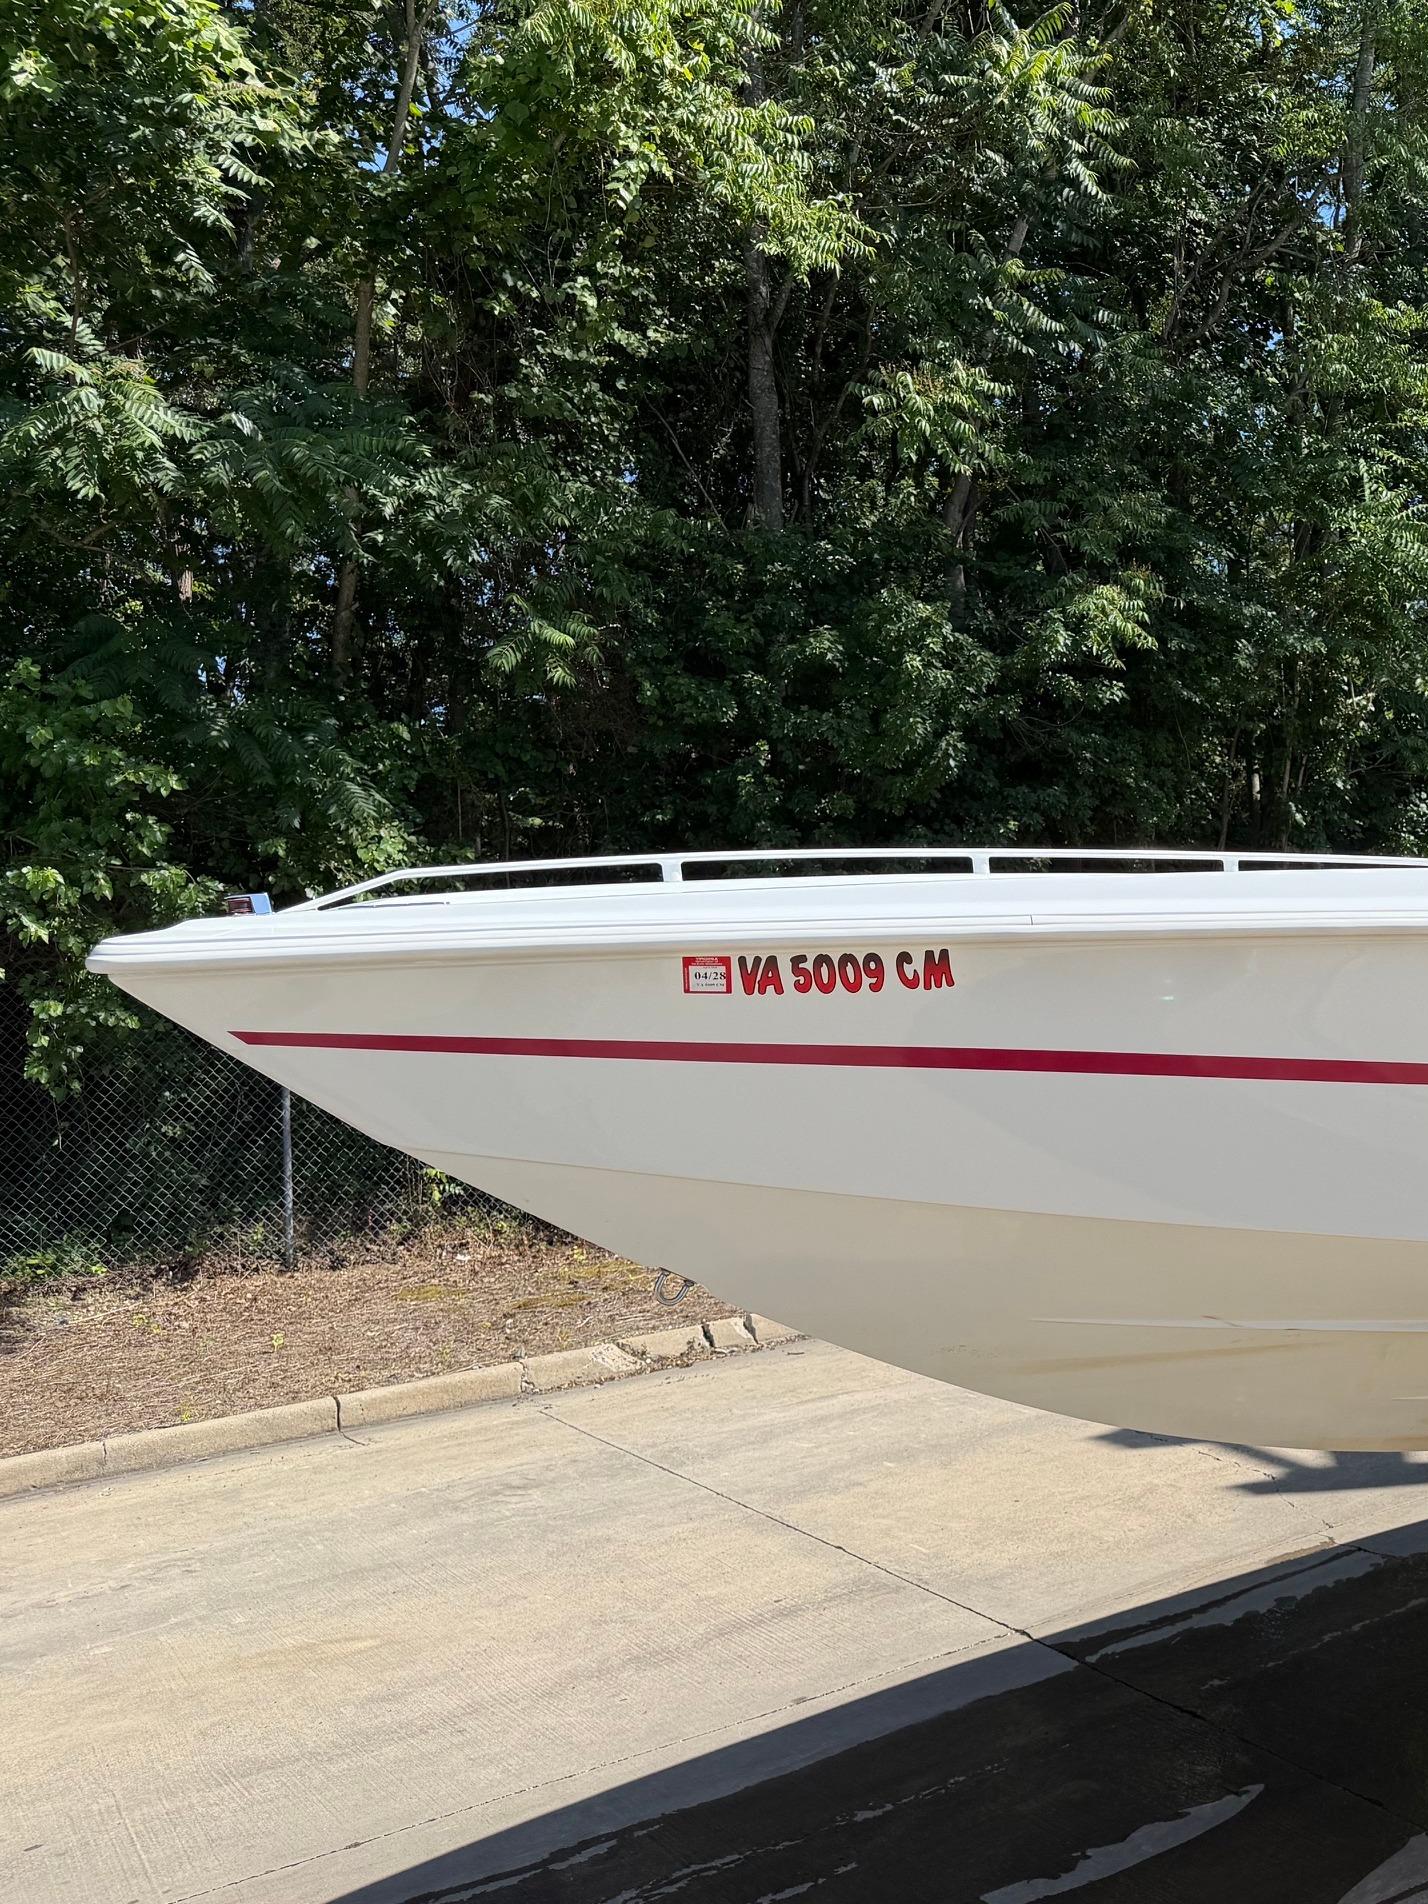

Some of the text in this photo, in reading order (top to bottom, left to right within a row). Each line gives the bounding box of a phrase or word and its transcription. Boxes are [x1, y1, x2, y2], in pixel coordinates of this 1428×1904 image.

[694, 971, 726, 980] 04/28
[737, 955, 784, 995] VA
[790, 953, 885, 994] 5009
[896, 948, 955, 990] CM
